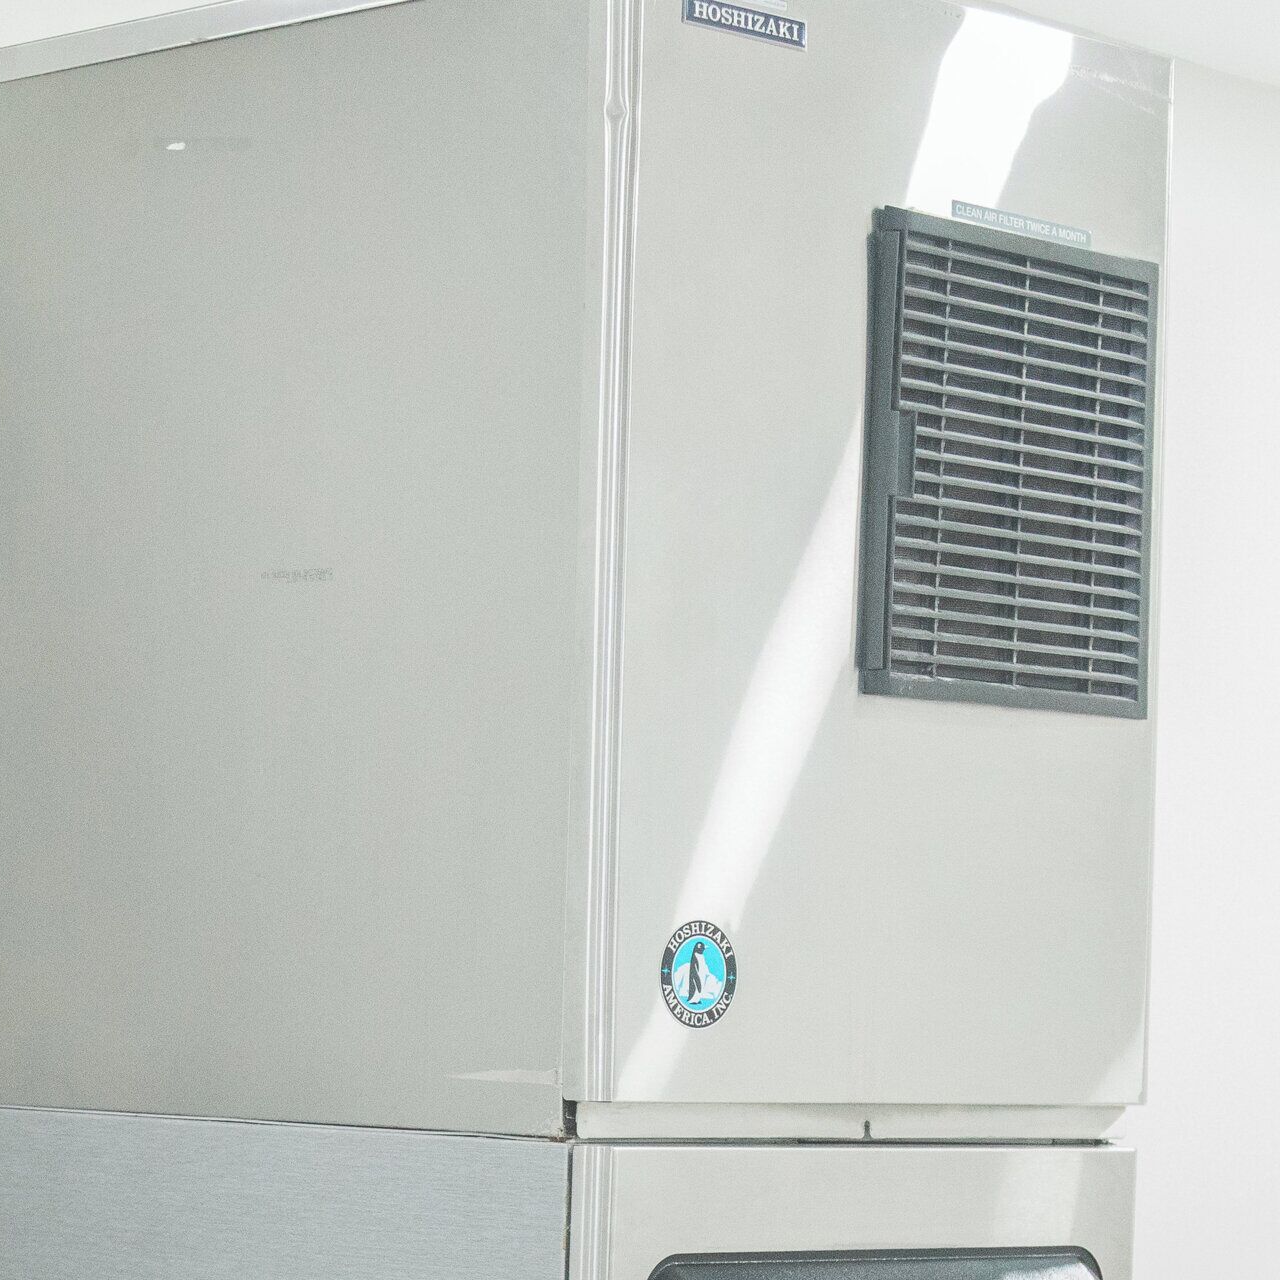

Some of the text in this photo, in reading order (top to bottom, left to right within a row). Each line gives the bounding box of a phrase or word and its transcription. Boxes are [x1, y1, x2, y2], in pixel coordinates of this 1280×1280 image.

[694, 0, 800, 41] HOSHIZAKI
[956, 204, 1086, 242] CLEAN AIR FILTER TWICE A MONTH
[668, 922, 733, 959] HOSHIZAKI
